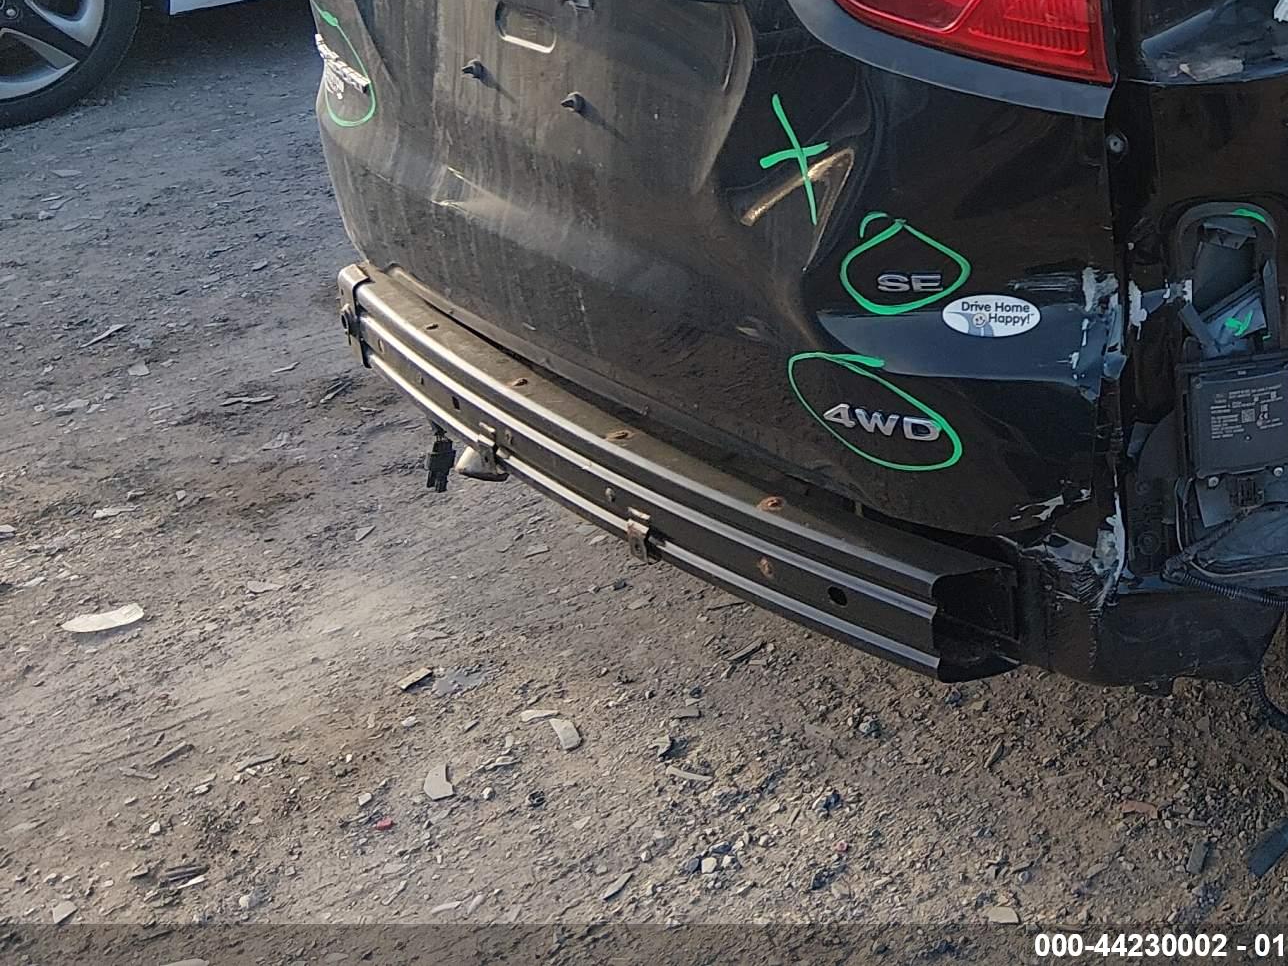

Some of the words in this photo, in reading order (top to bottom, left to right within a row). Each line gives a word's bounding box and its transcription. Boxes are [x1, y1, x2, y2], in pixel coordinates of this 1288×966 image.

[877, 273, 943, 293] SE
[961, 301, 992, 312] Drive
[995, 302, 1030, 313] Home
[988, 313, 1030, 326] Happy!
[823, 403, 942, 441] 4WD
